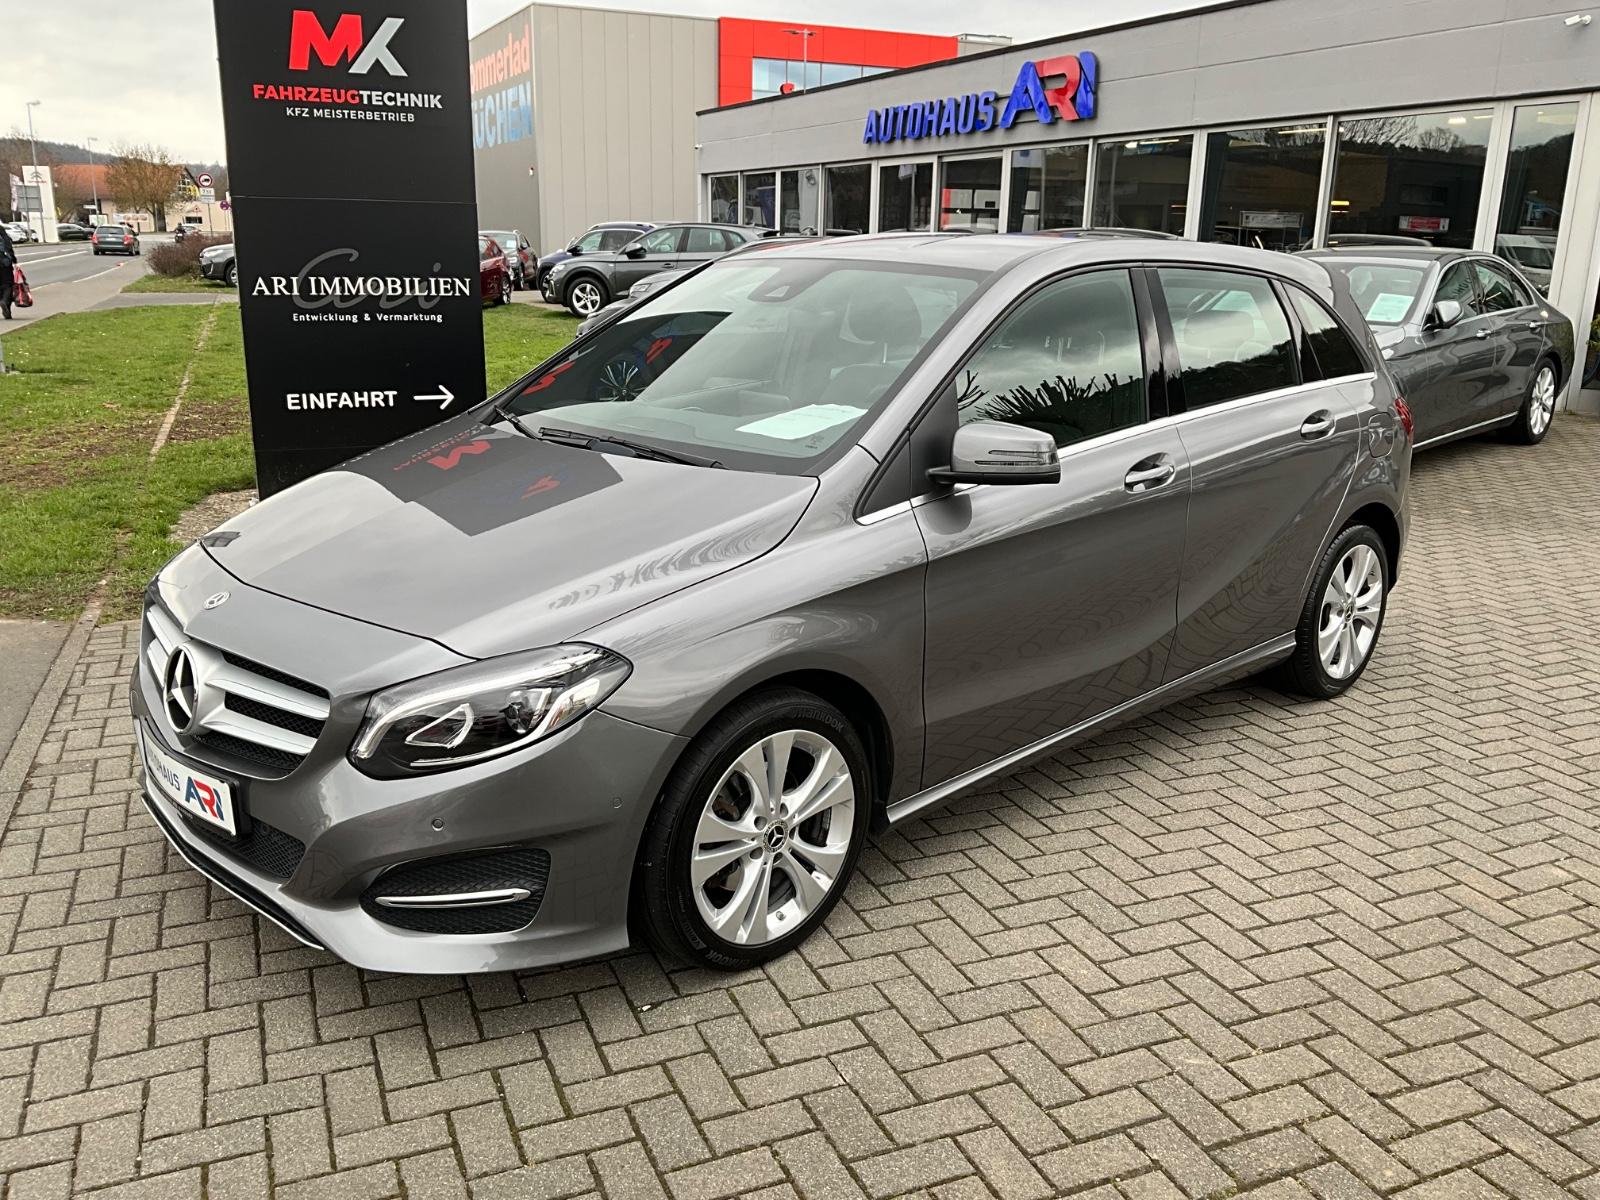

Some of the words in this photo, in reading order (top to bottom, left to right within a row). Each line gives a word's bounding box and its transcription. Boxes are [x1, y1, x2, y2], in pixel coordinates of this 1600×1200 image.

[289, 9, 408, 77] MK
[469, 23, 531, 95] ommerlad
[252, 83, 443, 109] FAHRZEUGTECHNIK
[863, 91, 998, 144] AUTOHAUS
[999, 51, 1098, 129] ARI
[286, 107, 310, 117] KFZ
[313, 108, 415, 122] MEISTERBETRIEB
[471, 80, 533, 149] ÜCHEN
[252, 276, 300, 296] ARI
[308, 276, 471, 296] IMMOBILIEN
[292, 313, 358, 323] Entwicklung
[363, 313, 371, 322] &
[376, 313, 443, 323] Vermarktung
[286, 390, 398, 410] EINFAHRT
[184, 775, 225, 821] ARI
